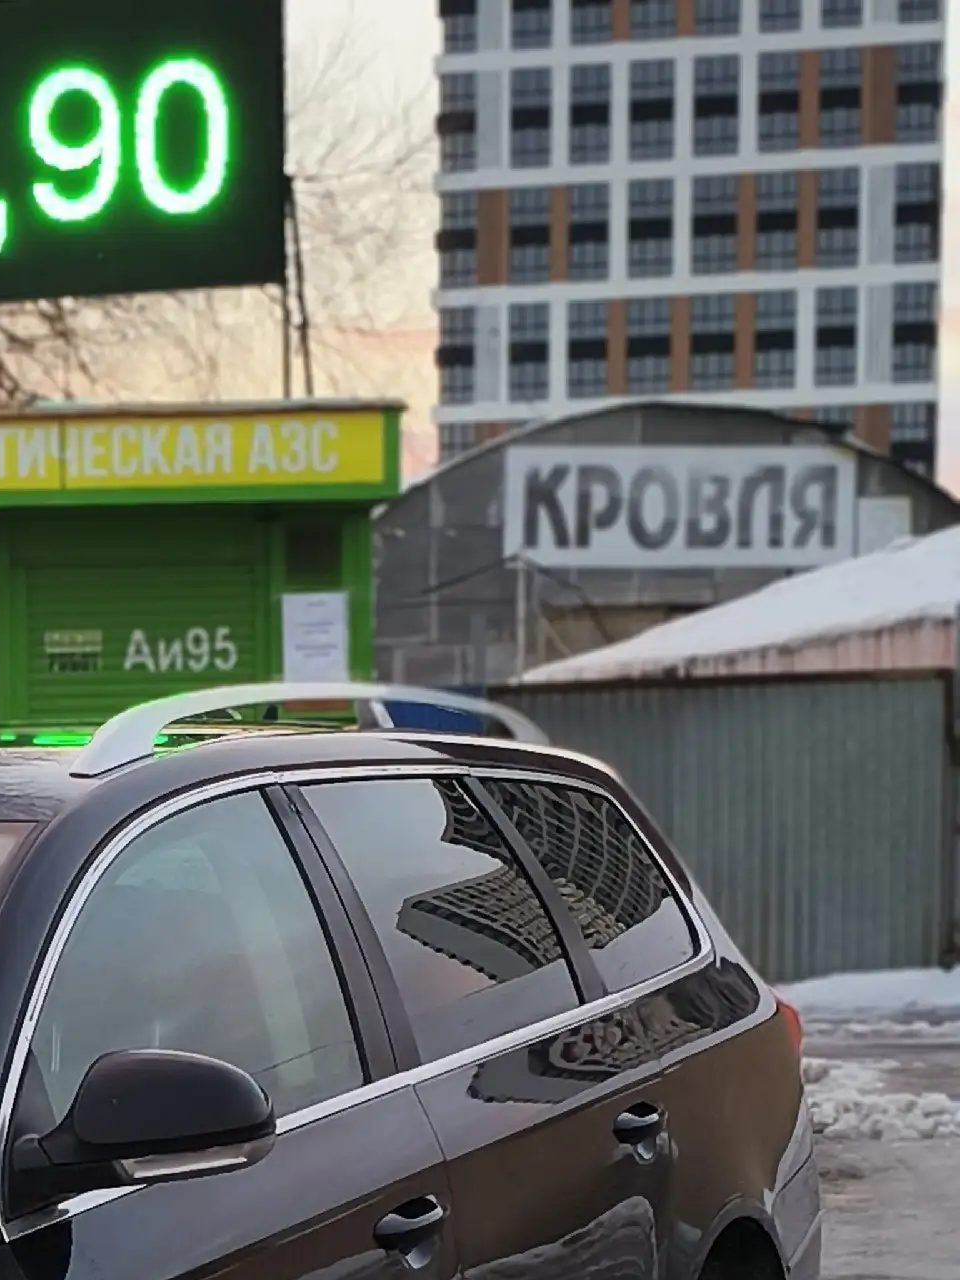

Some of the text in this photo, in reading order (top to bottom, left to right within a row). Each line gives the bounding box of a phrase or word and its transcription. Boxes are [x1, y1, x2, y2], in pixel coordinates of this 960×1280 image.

[247, 419, 338, 474] АЗС
[523, 463, 838, 552] КРОВЛЯ
[123, 625, 238, 673] Аи95
